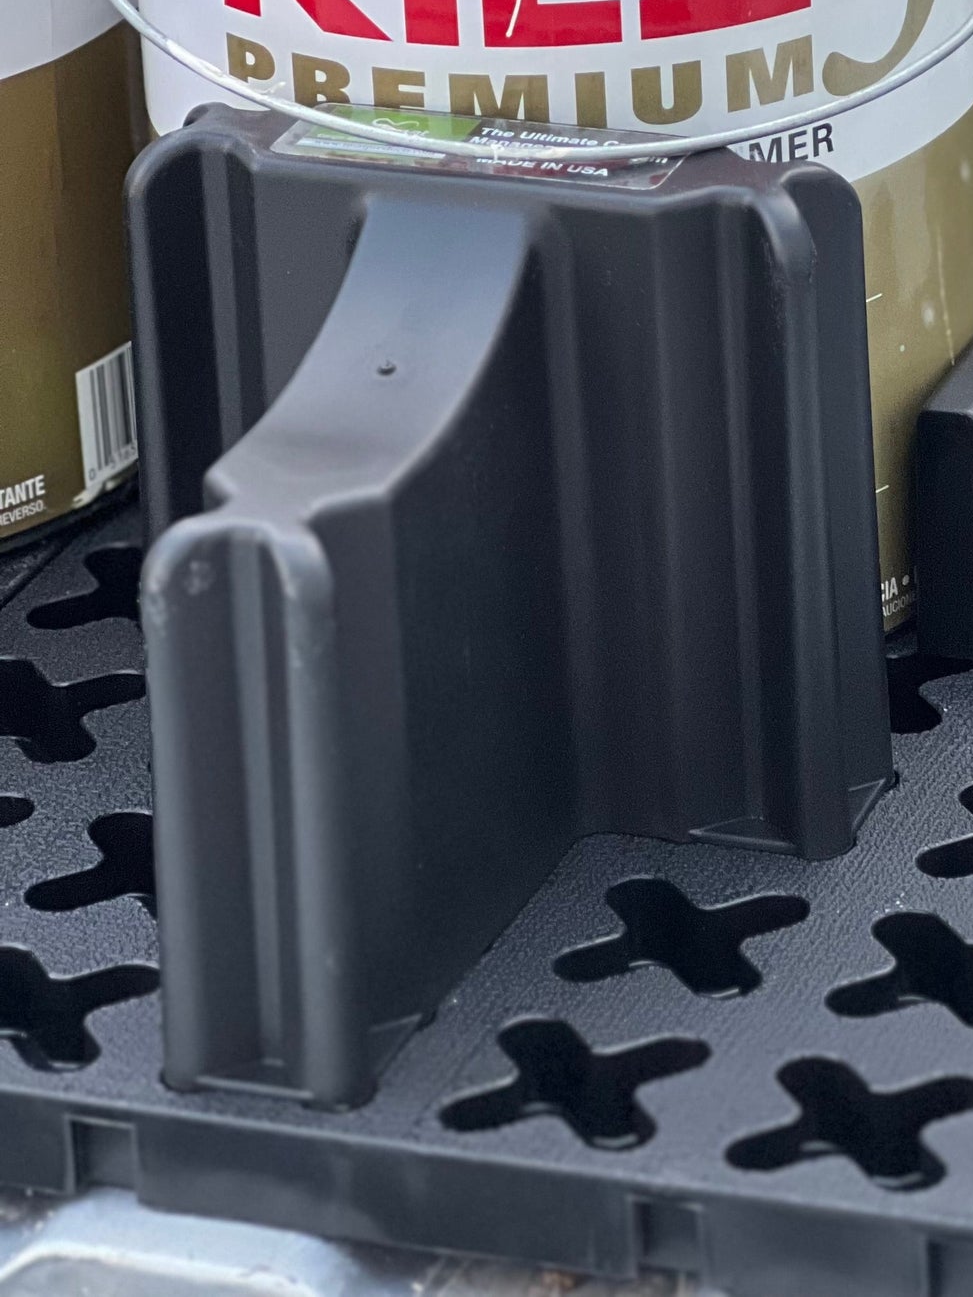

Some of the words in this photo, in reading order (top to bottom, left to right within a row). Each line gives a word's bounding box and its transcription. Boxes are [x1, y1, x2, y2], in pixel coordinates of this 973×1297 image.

[226, 32, 814, 127] PREMIUM
[481, 127, 515, 138] The
[520, 131, 599, 147] Ultimate
[749, 123, 834, 163] MER
[541, 161, 564, 171] IN
[567, 164, 610, 177] USA
